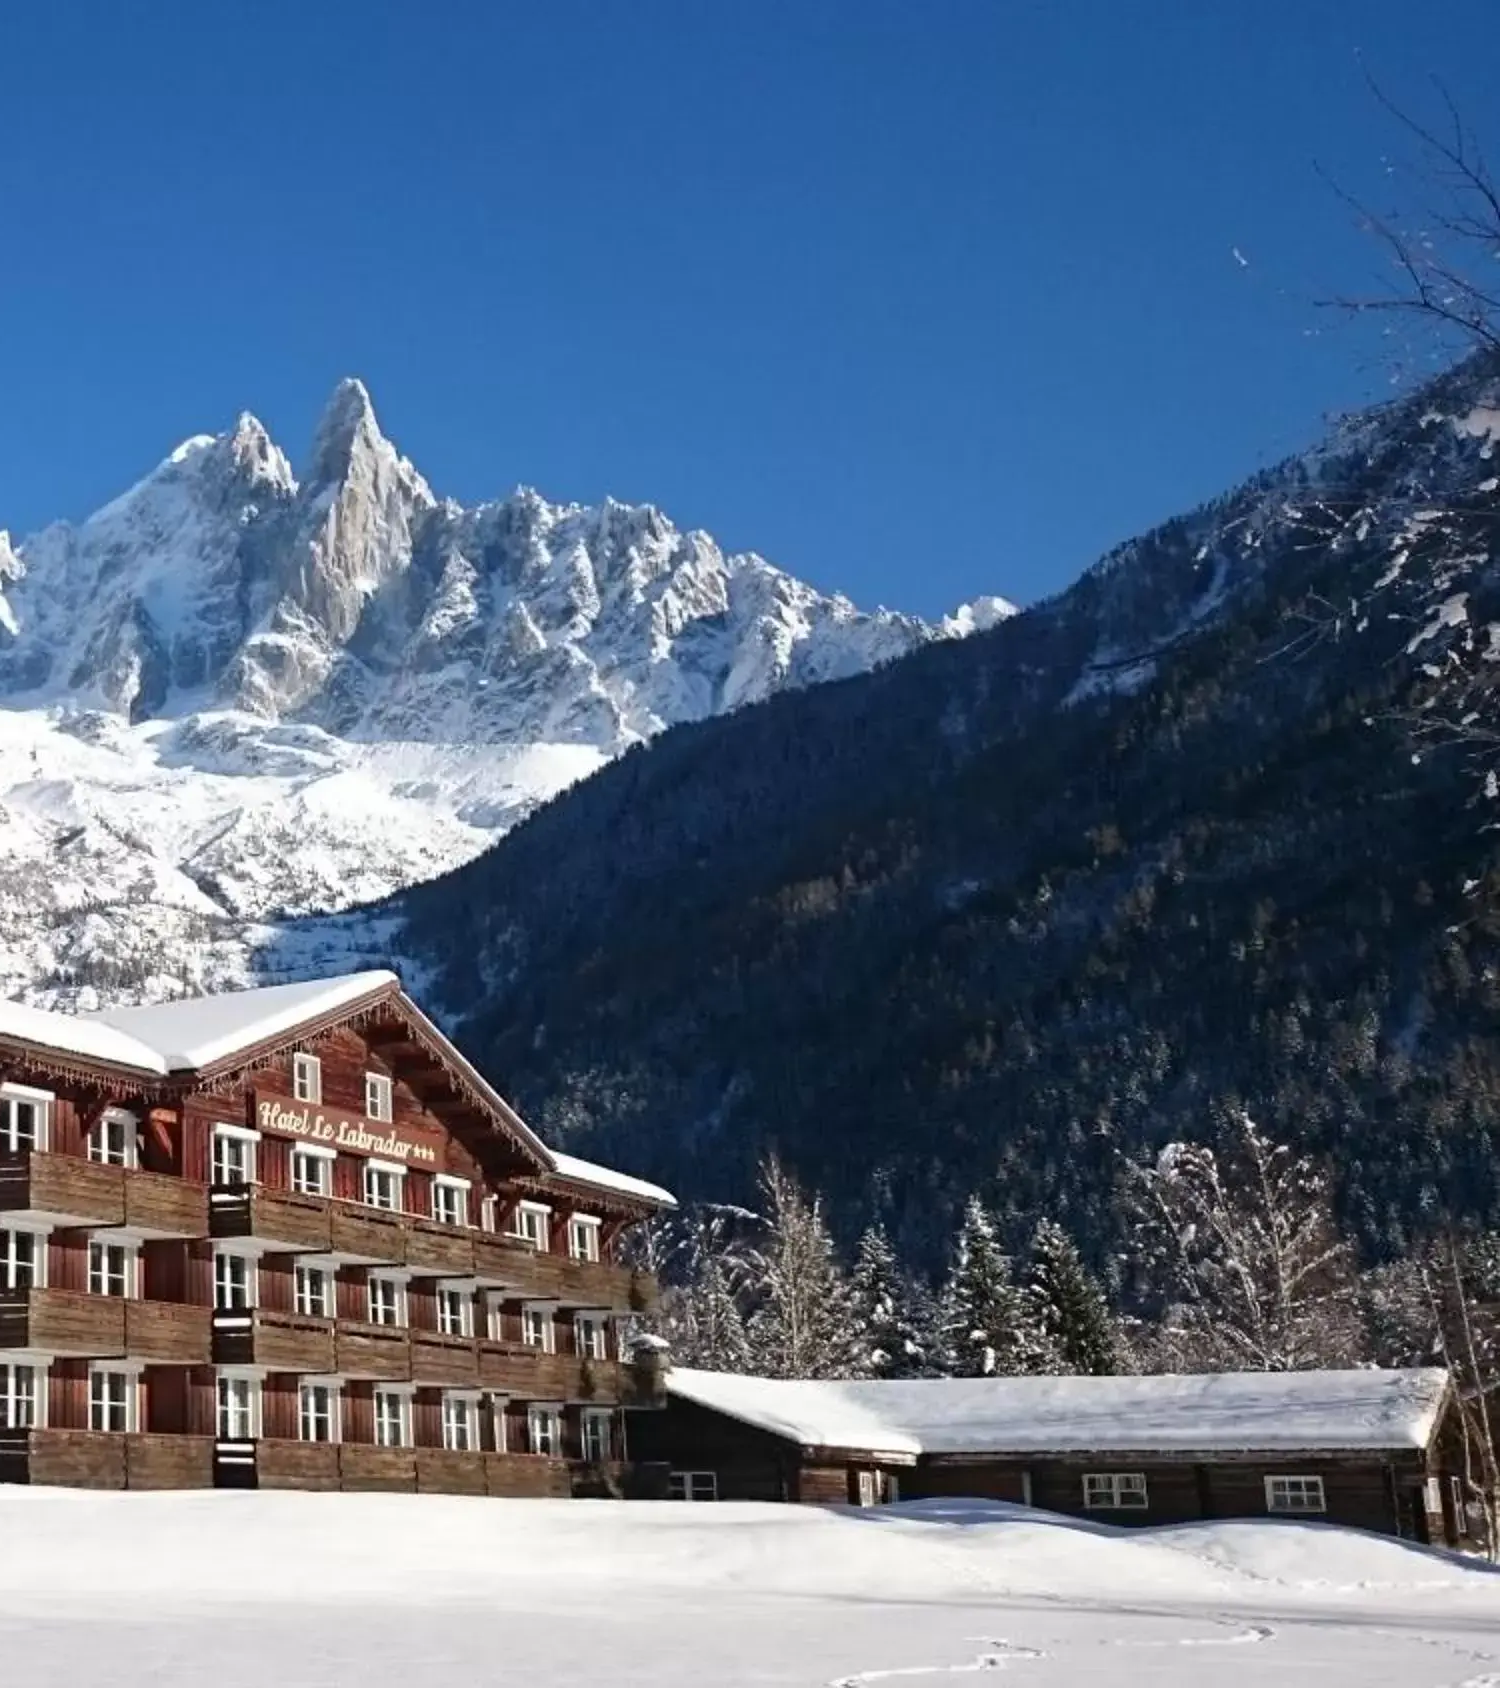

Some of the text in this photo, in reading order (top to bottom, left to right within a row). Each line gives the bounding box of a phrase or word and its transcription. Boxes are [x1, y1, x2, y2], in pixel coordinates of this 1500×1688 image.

[258, 1101, 412, 1159] Hotel Le Labrador
